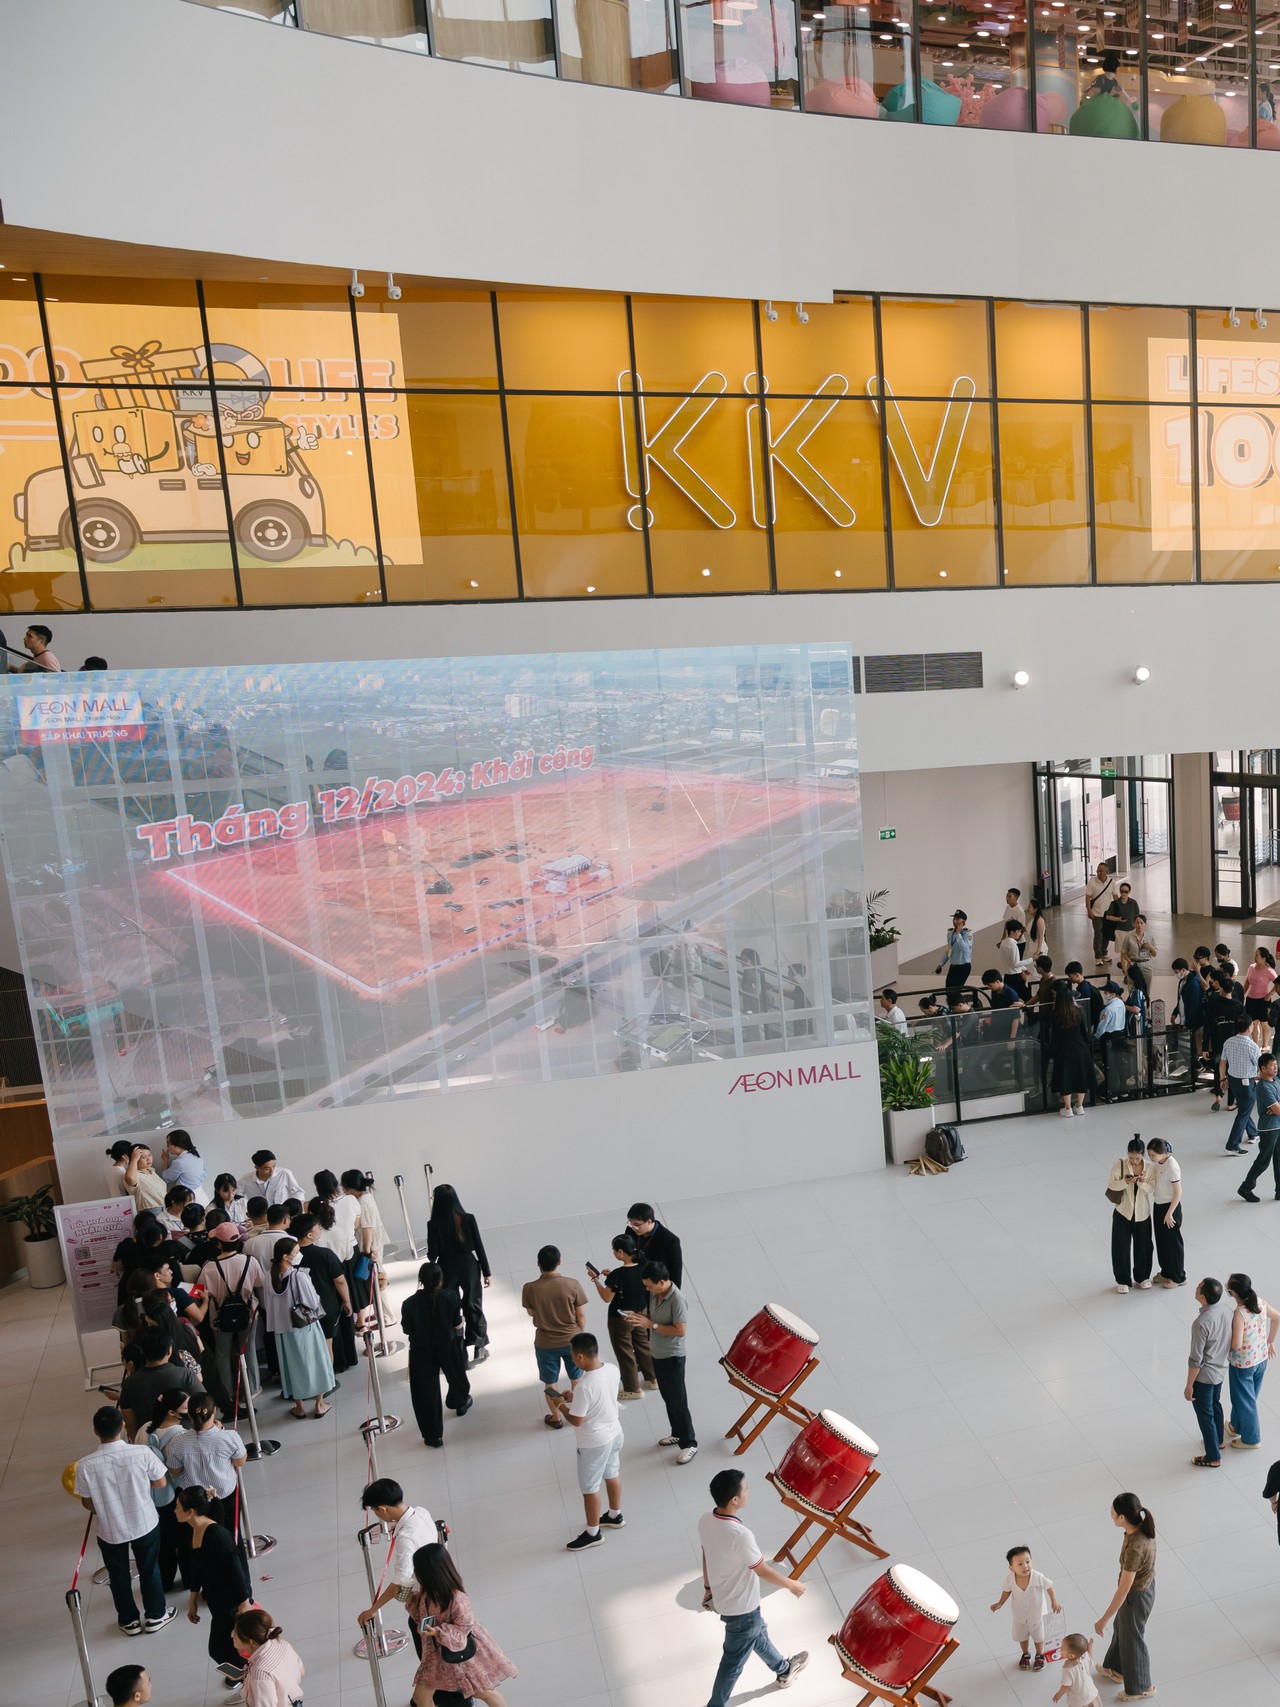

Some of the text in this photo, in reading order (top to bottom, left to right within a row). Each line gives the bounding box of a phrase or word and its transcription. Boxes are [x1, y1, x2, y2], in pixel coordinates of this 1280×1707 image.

[264, 357, 397, 402] LIFE
[280, 414, 399, 440] STYLES
[617, 369, 976, 531] KKV
[82, 698, 132, 712] MALL
[62, 731, 86, 740] KHAI
[136, 744, 596, 861] Tháng 12/2024: Khởi công
[797, 1061, 861, 1086] MALL
